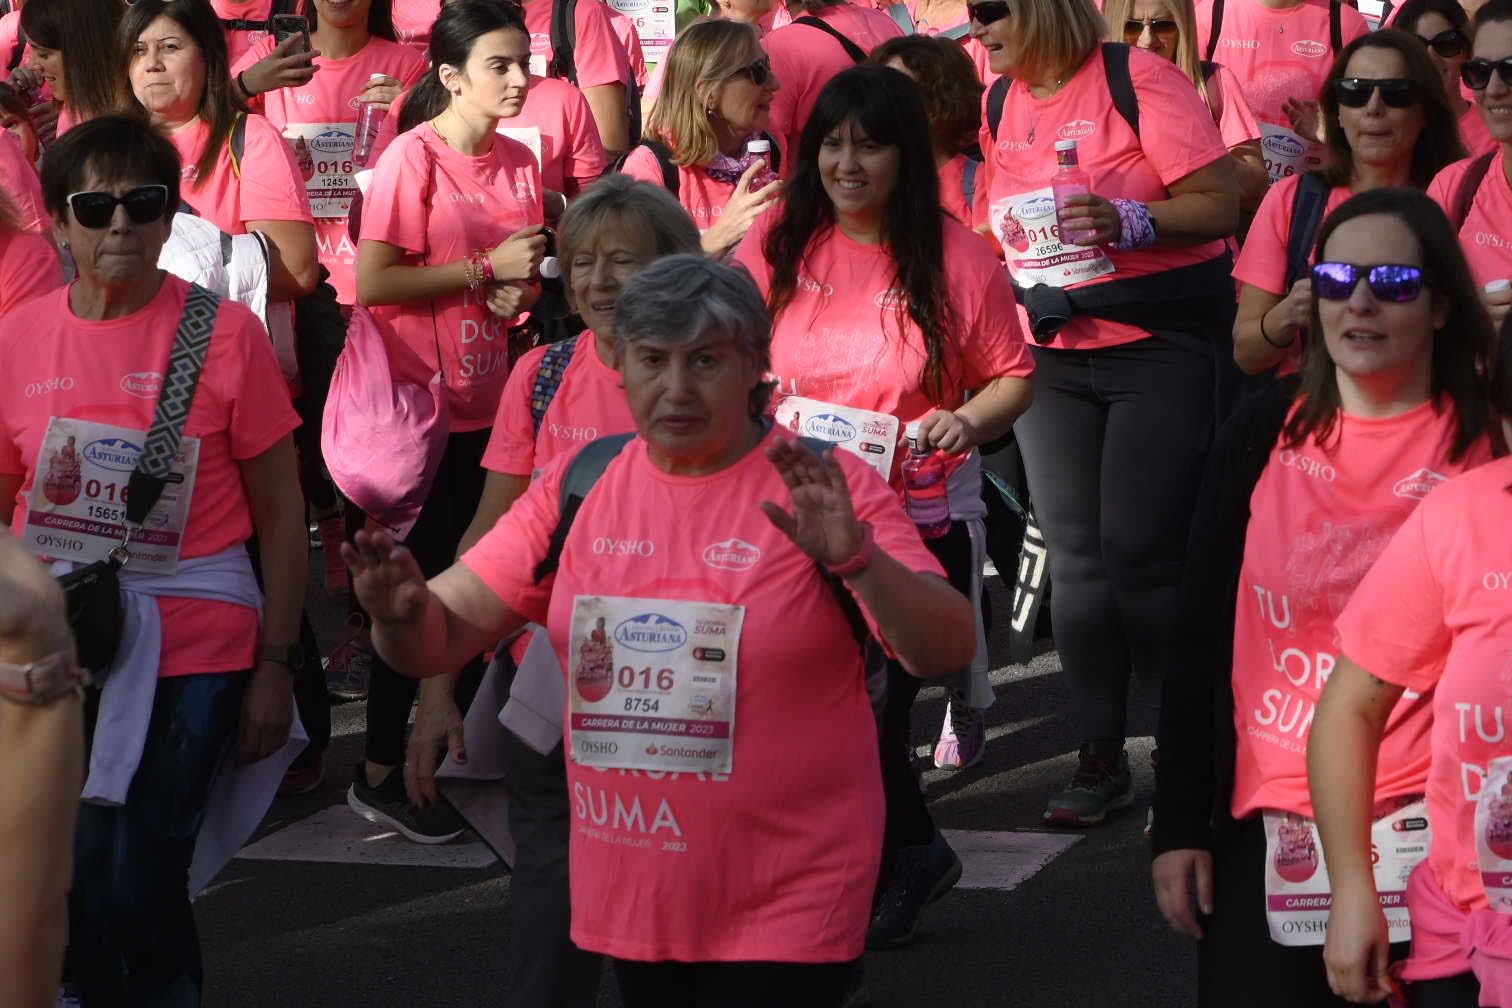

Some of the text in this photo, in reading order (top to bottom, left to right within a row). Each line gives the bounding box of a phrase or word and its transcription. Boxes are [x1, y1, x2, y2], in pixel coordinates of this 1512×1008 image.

[1221, 39, 1260, 49] OYSHO
[317, 160, 353, 174] 016
[321, 178, 349, 187] 12451
[1036, 243, 1063, 256] 26596
[25, 376, 74, 398] OYSHO
[1279, 449, 1337, 482] OYSHO
[87, 506, 126, 521] 15651
[44, 516, 86, 531] CARRERA
[87, 524, 100, 533] DE
[101, 526, 113, 535] LA
[36, 534, 84, 552] OYSHO
[593, 537, 654, 557] OYSHO
[1253, 585, 1291, 629] TU
[621, 627, 682, 644] ASTURIANA
[694, 625, 727, 636] SUMA
[618, 665, 674, 691] 016
[624, 697, 660, 713] 8754
[581, 717, 715, 735] CARRERA DE LA MUJER 2023
[1455, 702, 1503, 743] TU
[581, 740, 618, 755] OYSHO
[659, 745, 719, 760] Santander
[574, 781, 684, 838] SUMA
